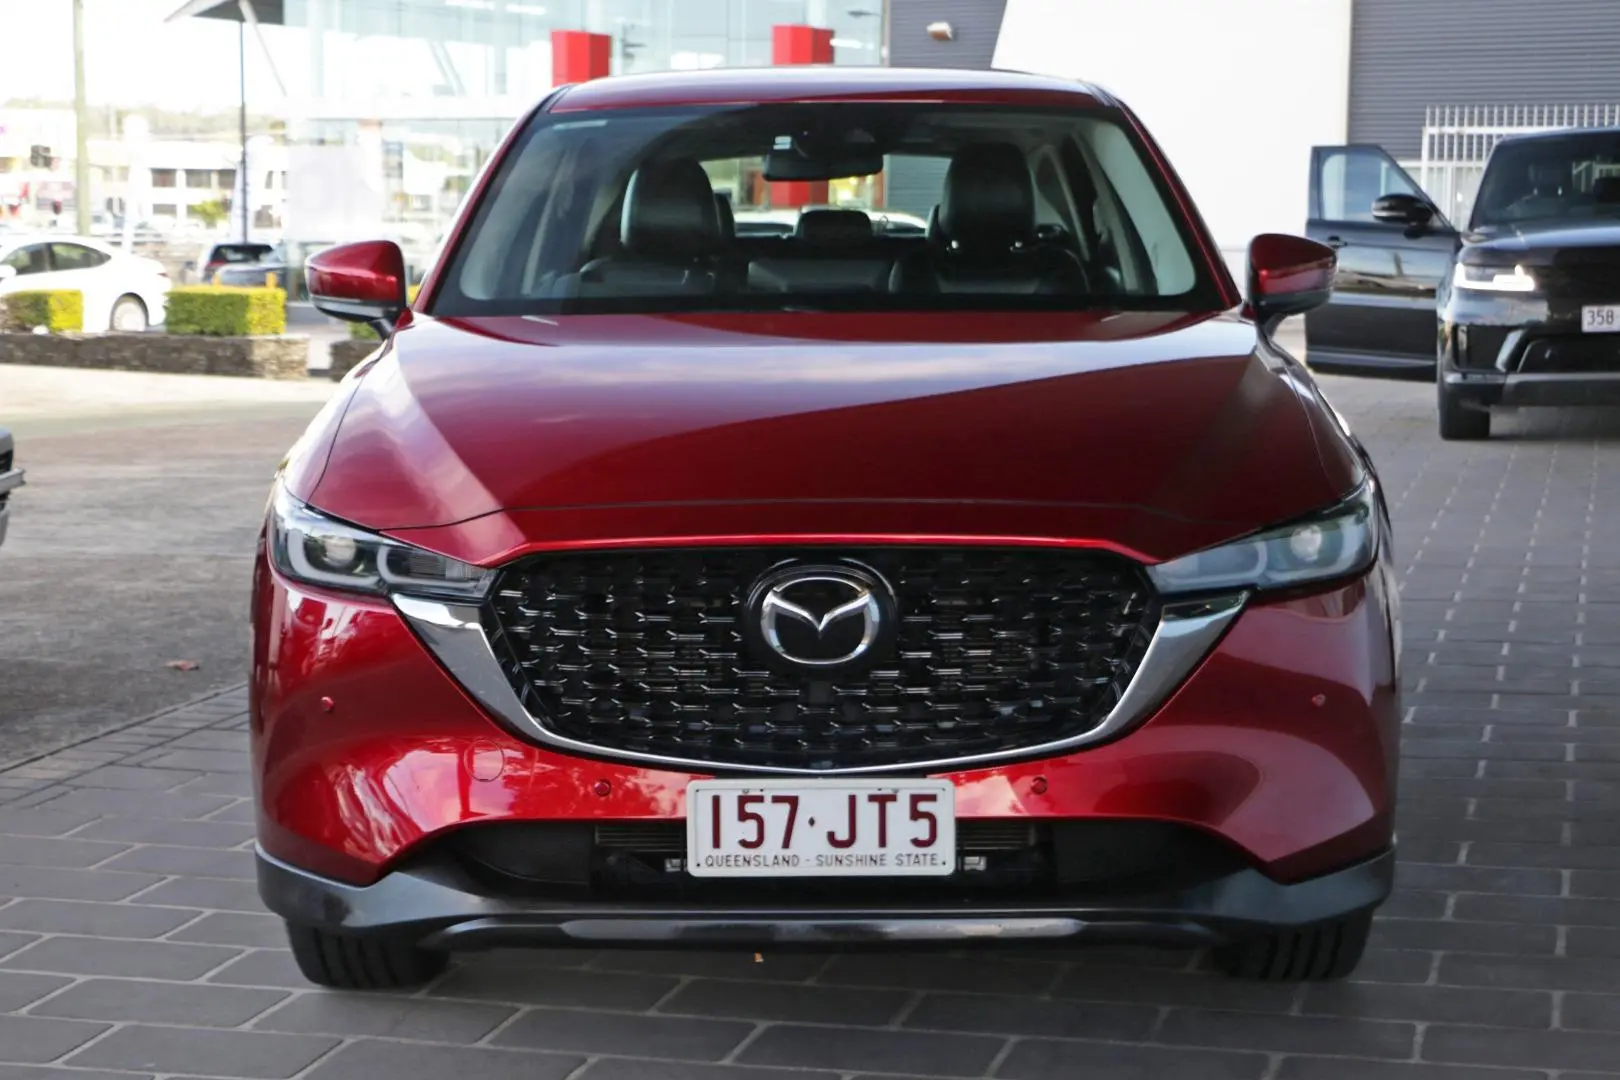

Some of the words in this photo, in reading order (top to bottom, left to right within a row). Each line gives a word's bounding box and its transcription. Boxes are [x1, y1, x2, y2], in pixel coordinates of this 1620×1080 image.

[1587, 309, 1614, 326] 358
[705, 854, 800, 867] QUEENSLAND
[815, 854, 887, 867] SUNSHINE
[895, 853, 938, 866] STATE
